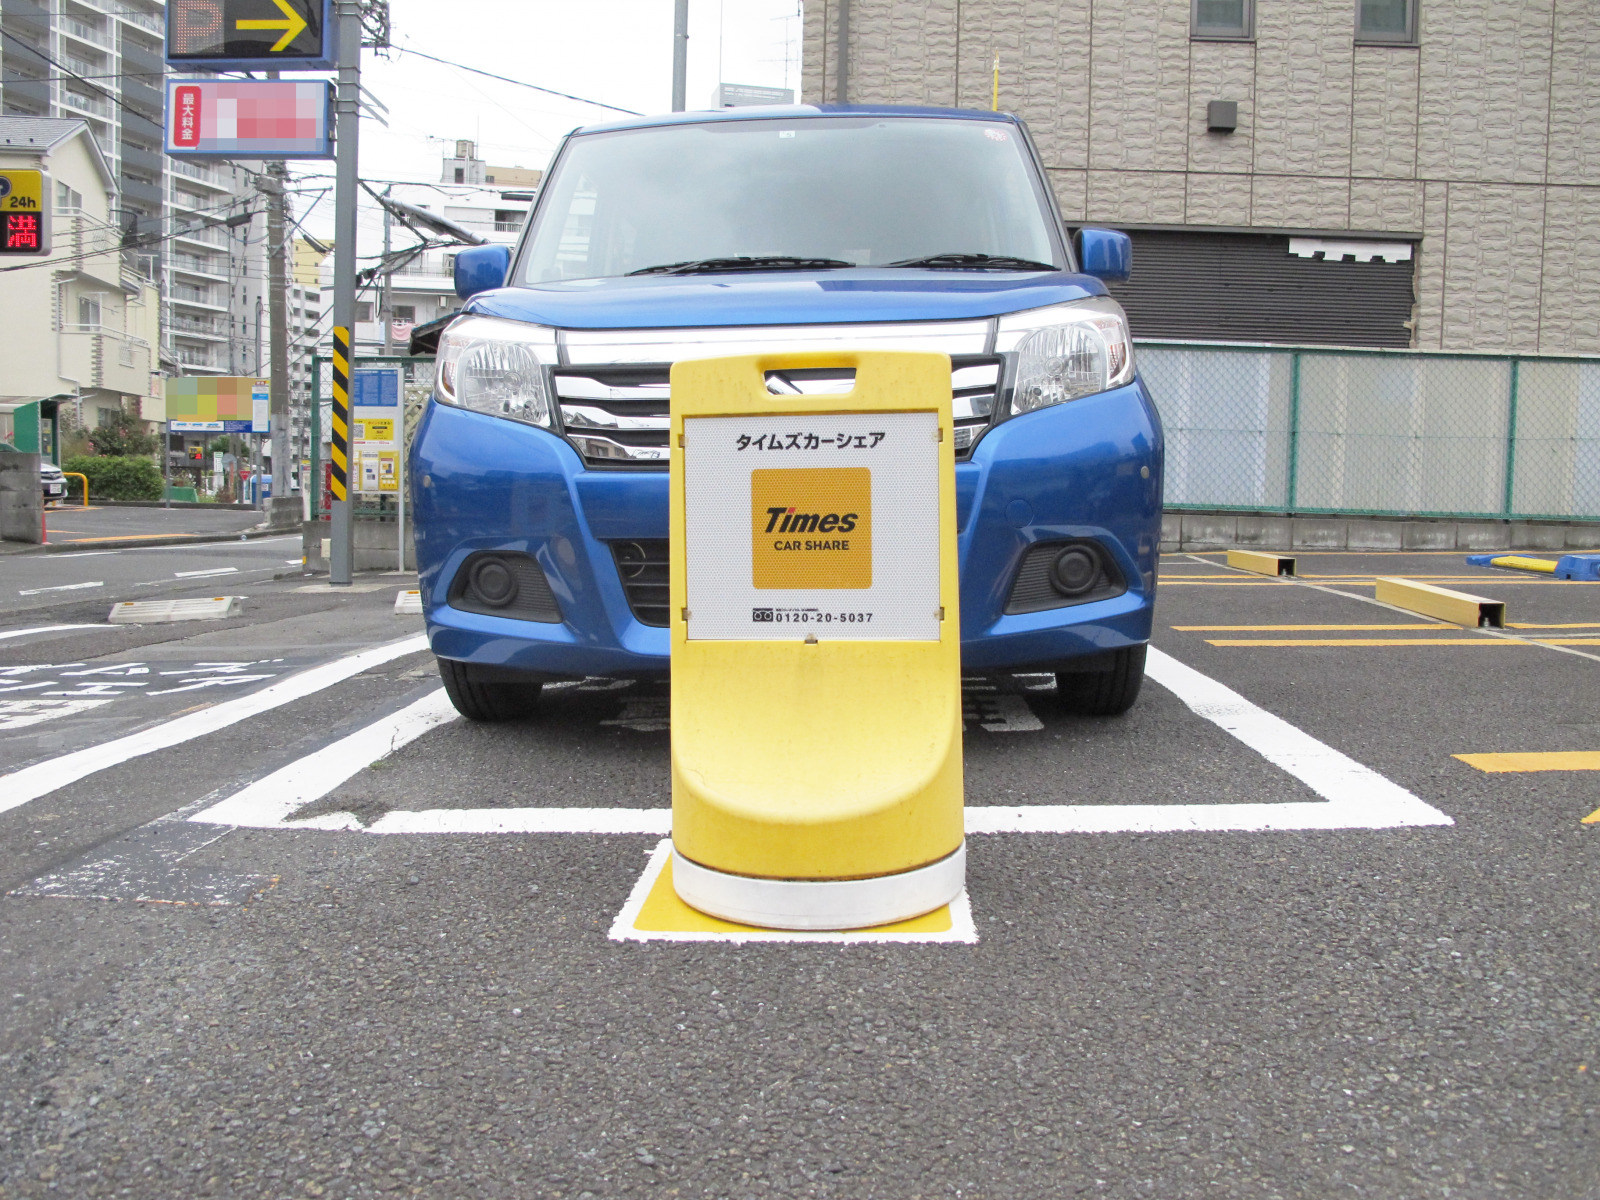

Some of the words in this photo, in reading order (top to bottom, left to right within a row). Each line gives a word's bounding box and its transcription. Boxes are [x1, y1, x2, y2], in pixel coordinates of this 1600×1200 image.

[181, 93, 195, 140] 最大料金
[10, 196, 36, 208] 24h
[8, 215, 37, 247] 満
[736, 432, 886, 451] タイムズカーシェア
[765, 507, 859, 534] Times
[774, 541, 801, 551] CAR
[805, 540, 849, 551] SHARE
[775, 613, 873, 623] 0120-20-5037
